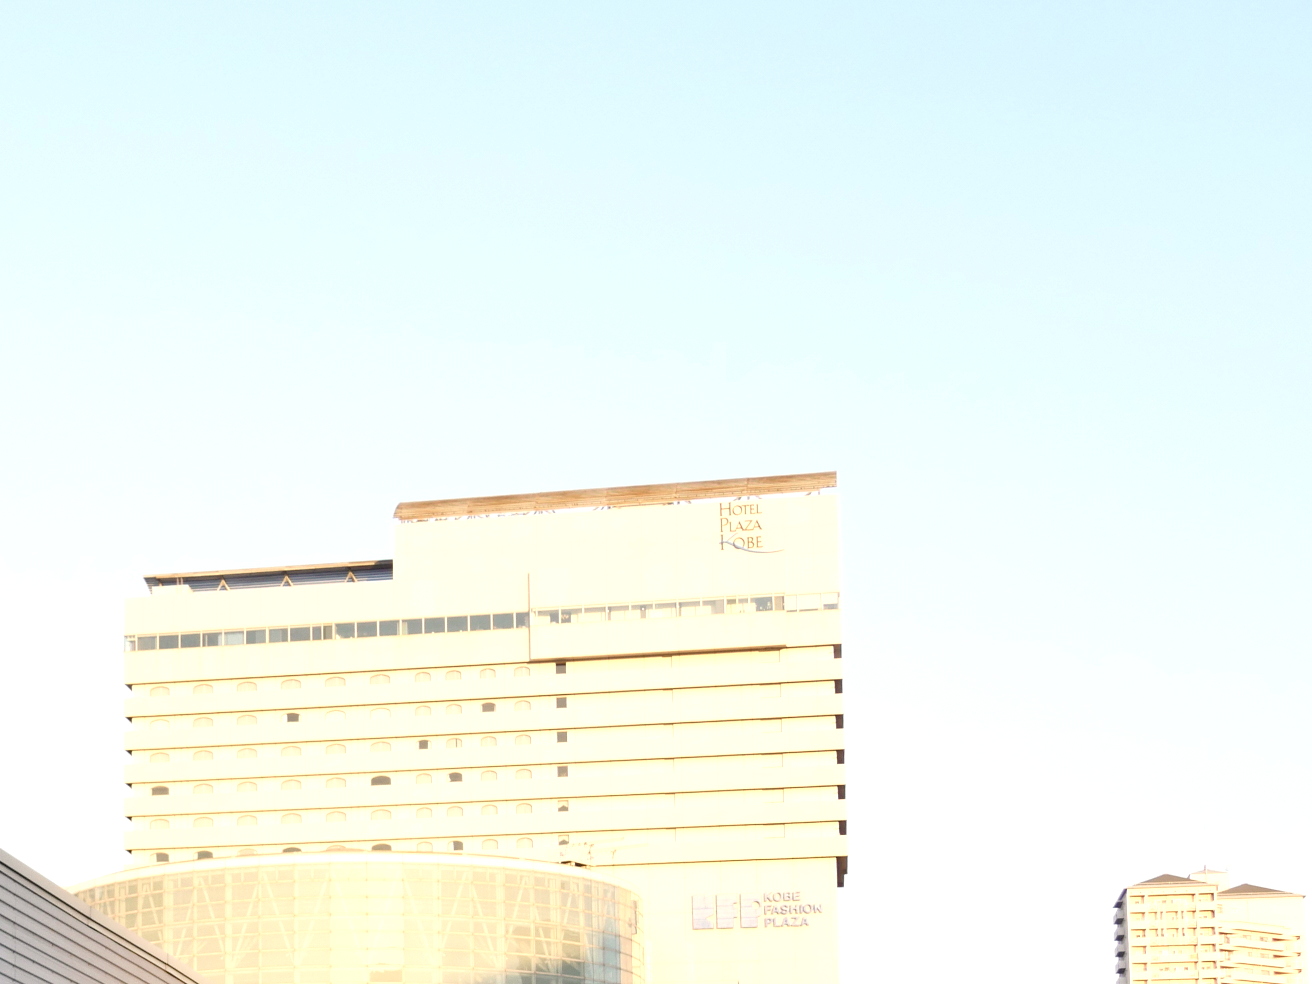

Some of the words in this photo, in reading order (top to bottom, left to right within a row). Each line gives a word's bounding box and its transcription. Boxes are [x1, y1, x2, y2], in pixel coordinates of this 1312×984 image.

[719, 502, 763, 516] HOTEL
[720, 517, 763, 533] PLAZA
[719, 533, 764, 550] KOBE
[763, 891, 801, 903] KOBE
[763, 904, 823, 916] FASHION
[763, 916, 809, 928] PLAZA
